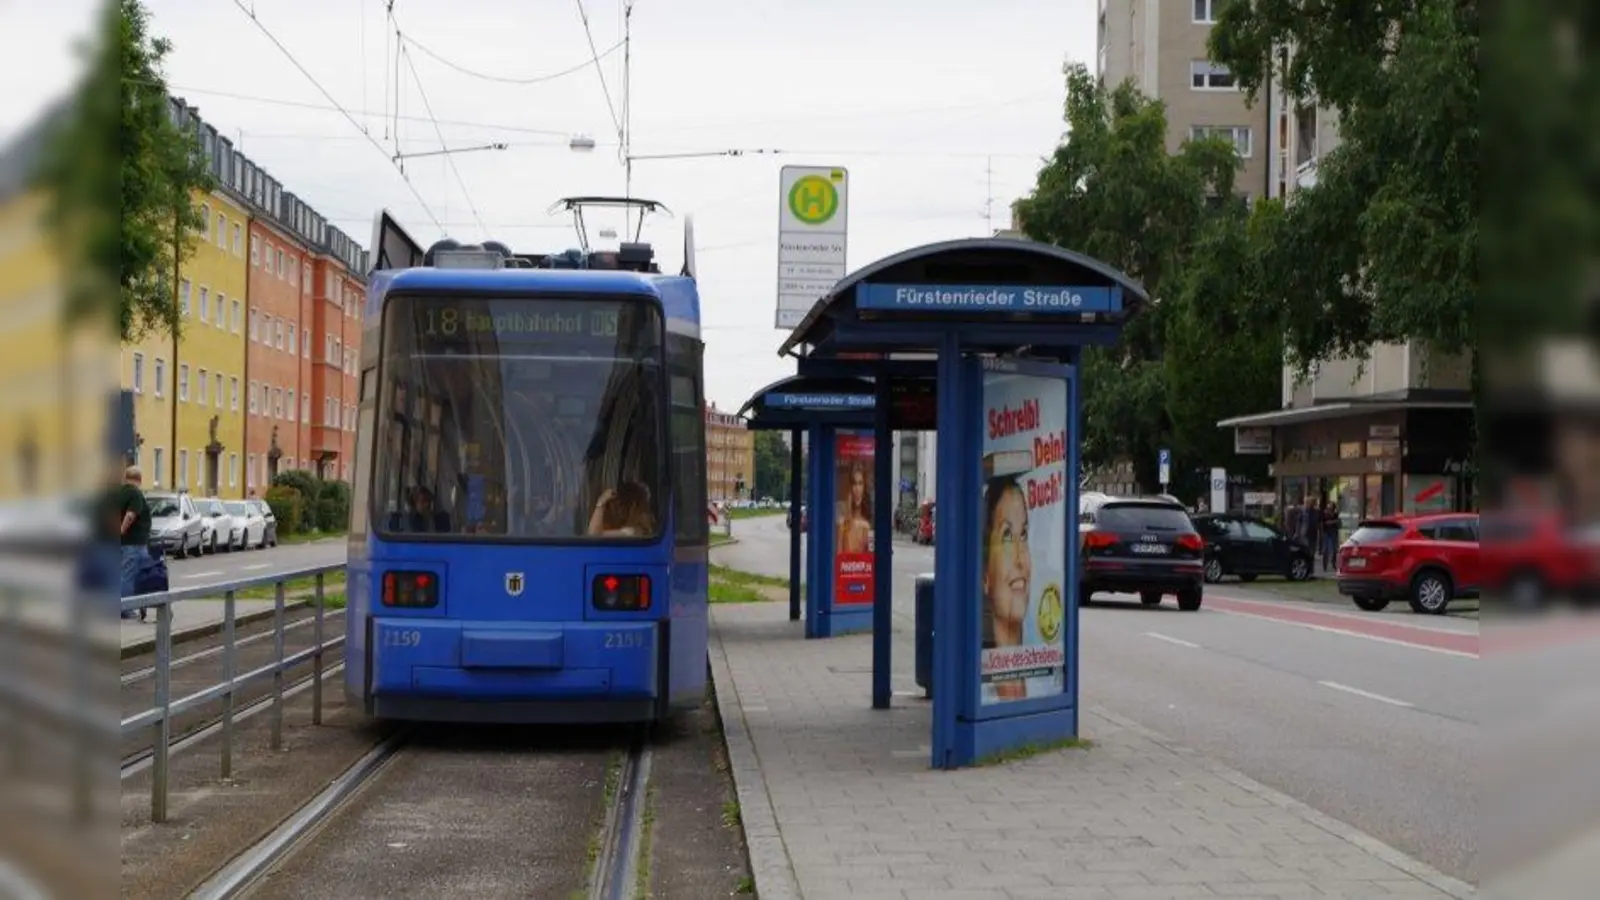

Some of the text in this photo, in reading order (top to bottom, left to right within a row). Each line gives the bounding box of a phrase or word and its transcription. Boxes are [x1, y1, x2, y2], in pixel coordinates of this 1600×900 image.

[801, 187, 826, 213] H
[895, 287, 1083, 307] Fürstenrieder Straße
[426, 308, 458, 335] 18
[988, 398, 1041, 440] Schreib!
[1033, 431, 1066, 468] Dein!
[1026, 471, 1063, 510] Buch!
[384, 629, 421, 647] 2159
